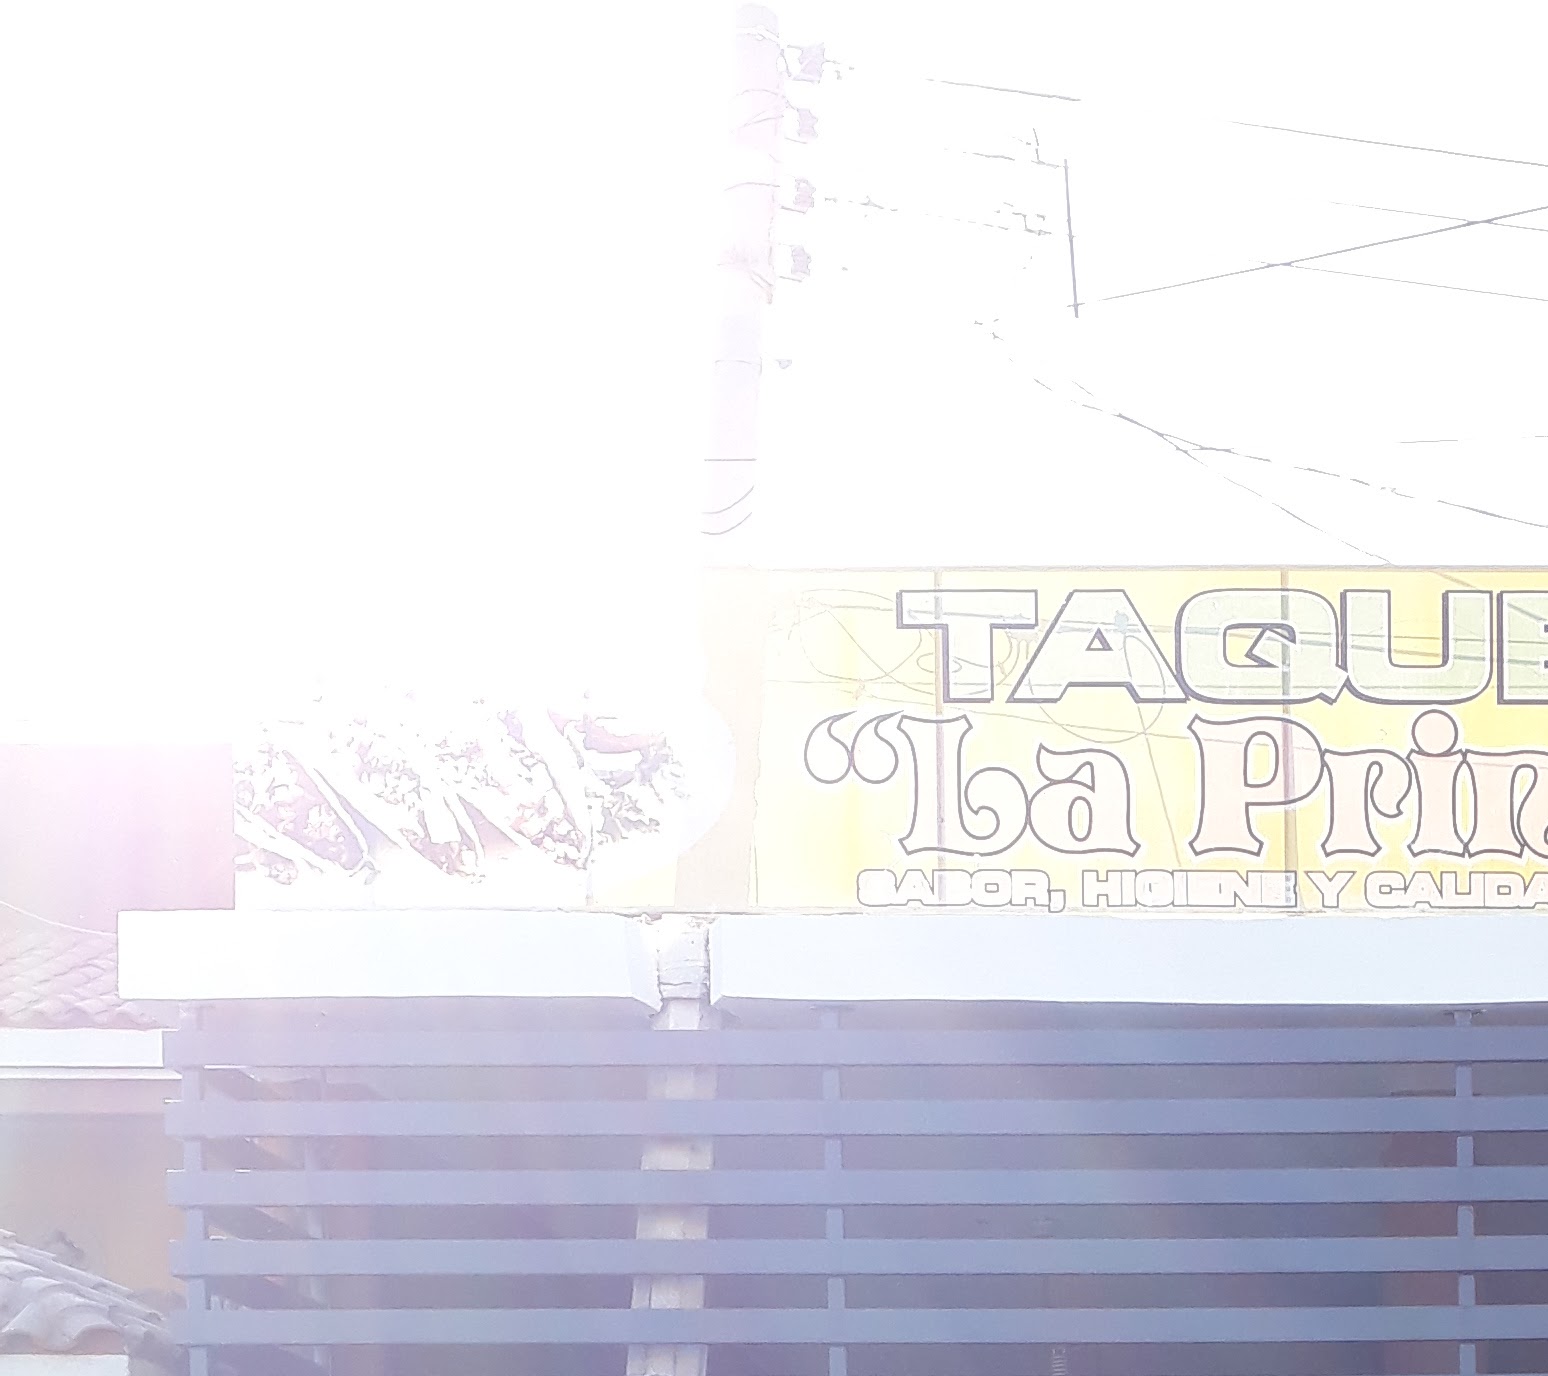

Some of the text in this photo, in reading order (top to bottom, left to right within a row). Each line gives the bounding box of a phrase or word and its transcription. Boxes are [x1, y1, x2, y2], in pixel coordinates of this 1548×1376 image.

[856, 868, 1066, 912] SABOR,
[1082, 869, 1298, 908] HIGIENE
[1304, 870, 1357, 909] Y
